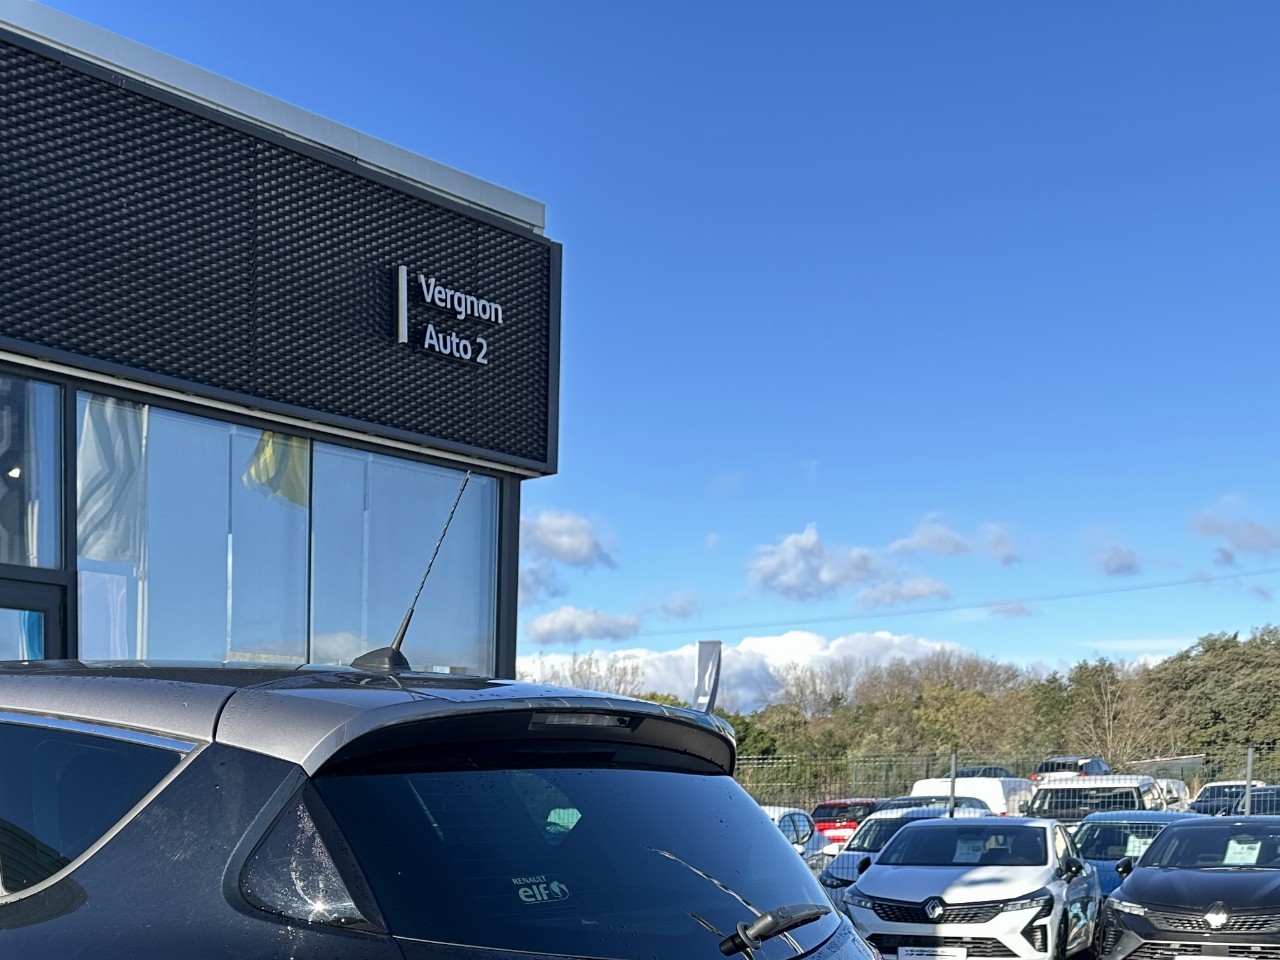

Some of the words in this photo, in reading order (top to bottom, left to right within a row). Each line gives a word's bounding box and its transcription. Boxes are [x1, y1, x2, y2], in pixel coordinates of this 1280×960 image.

[418, 273, 503, 324] Vergnon
[424, 323, 472, 360] Auto
[476, 337, 488, 365] 2
[511, 875, 547, 885] RENAULT
[518, 883, 550, 902] elf
